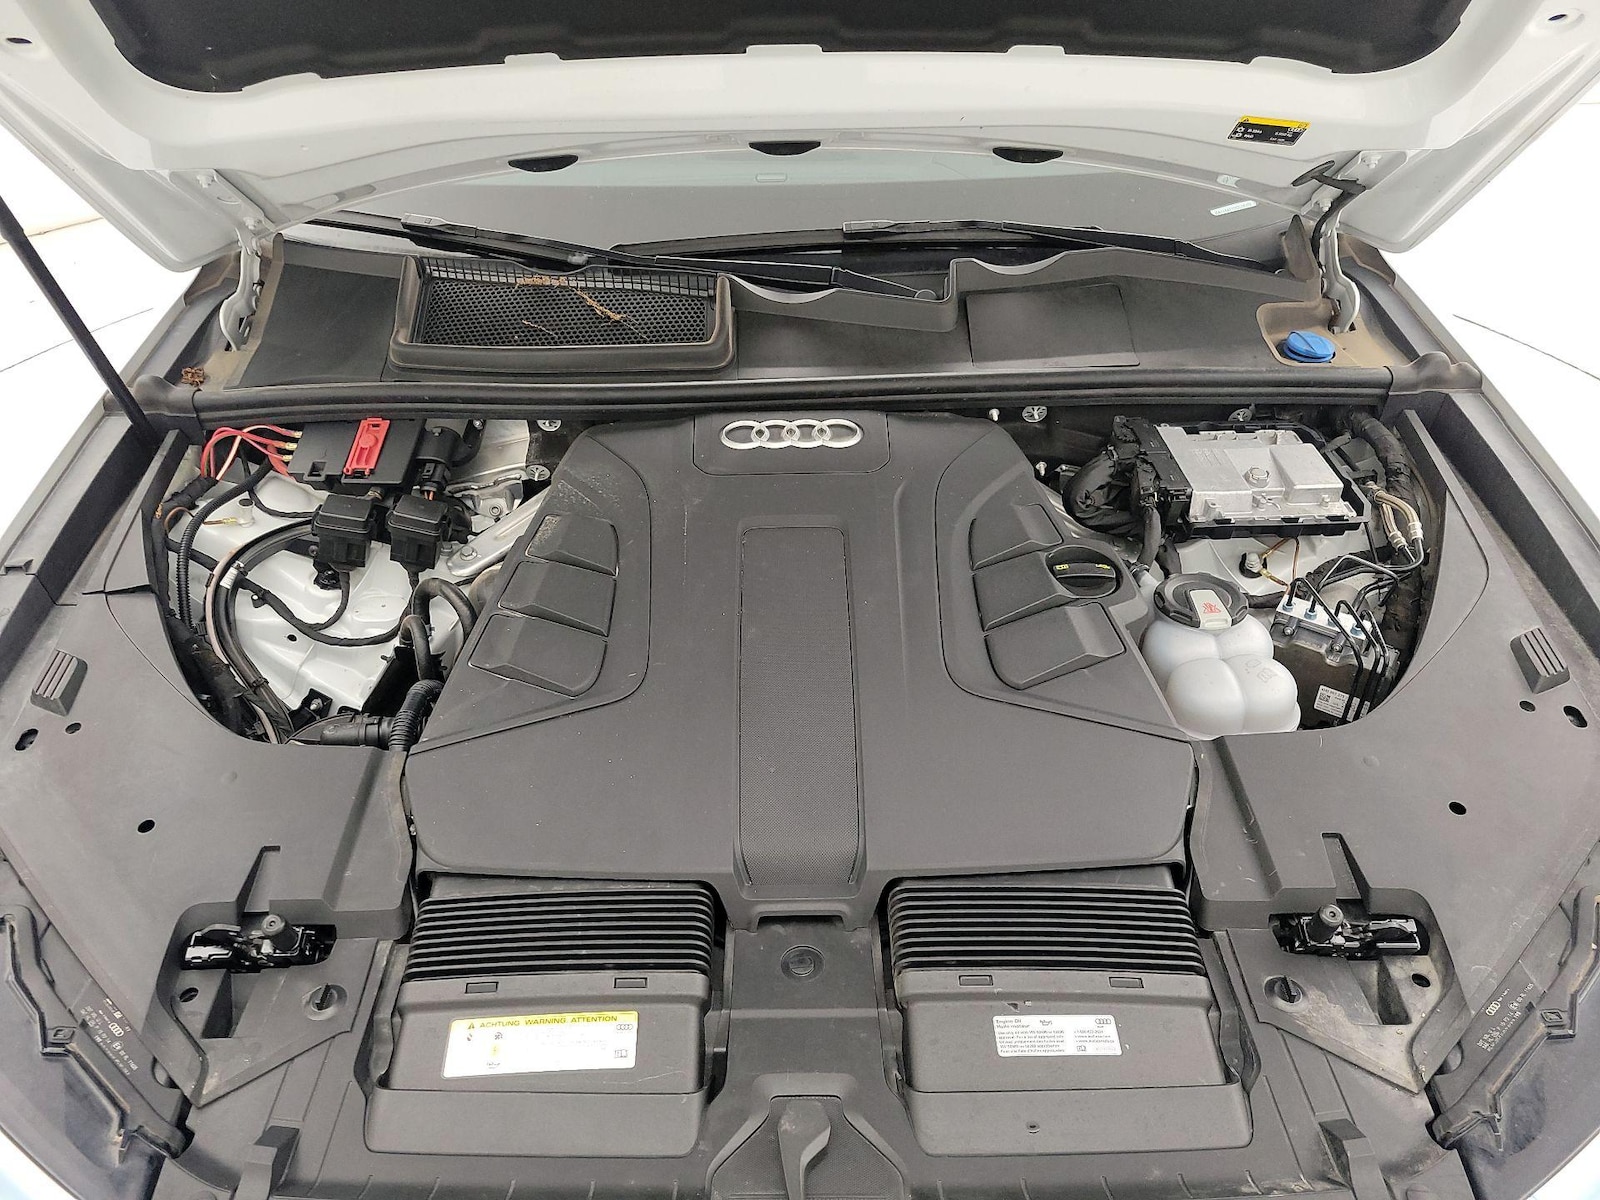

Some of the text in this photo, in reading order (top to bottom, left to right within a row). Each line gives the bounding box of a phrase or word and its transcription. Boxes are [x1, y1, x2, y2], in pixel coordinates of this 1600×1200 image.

[479, 1015, 618, 1028] ACHTUNG WARNING ATTENTION
